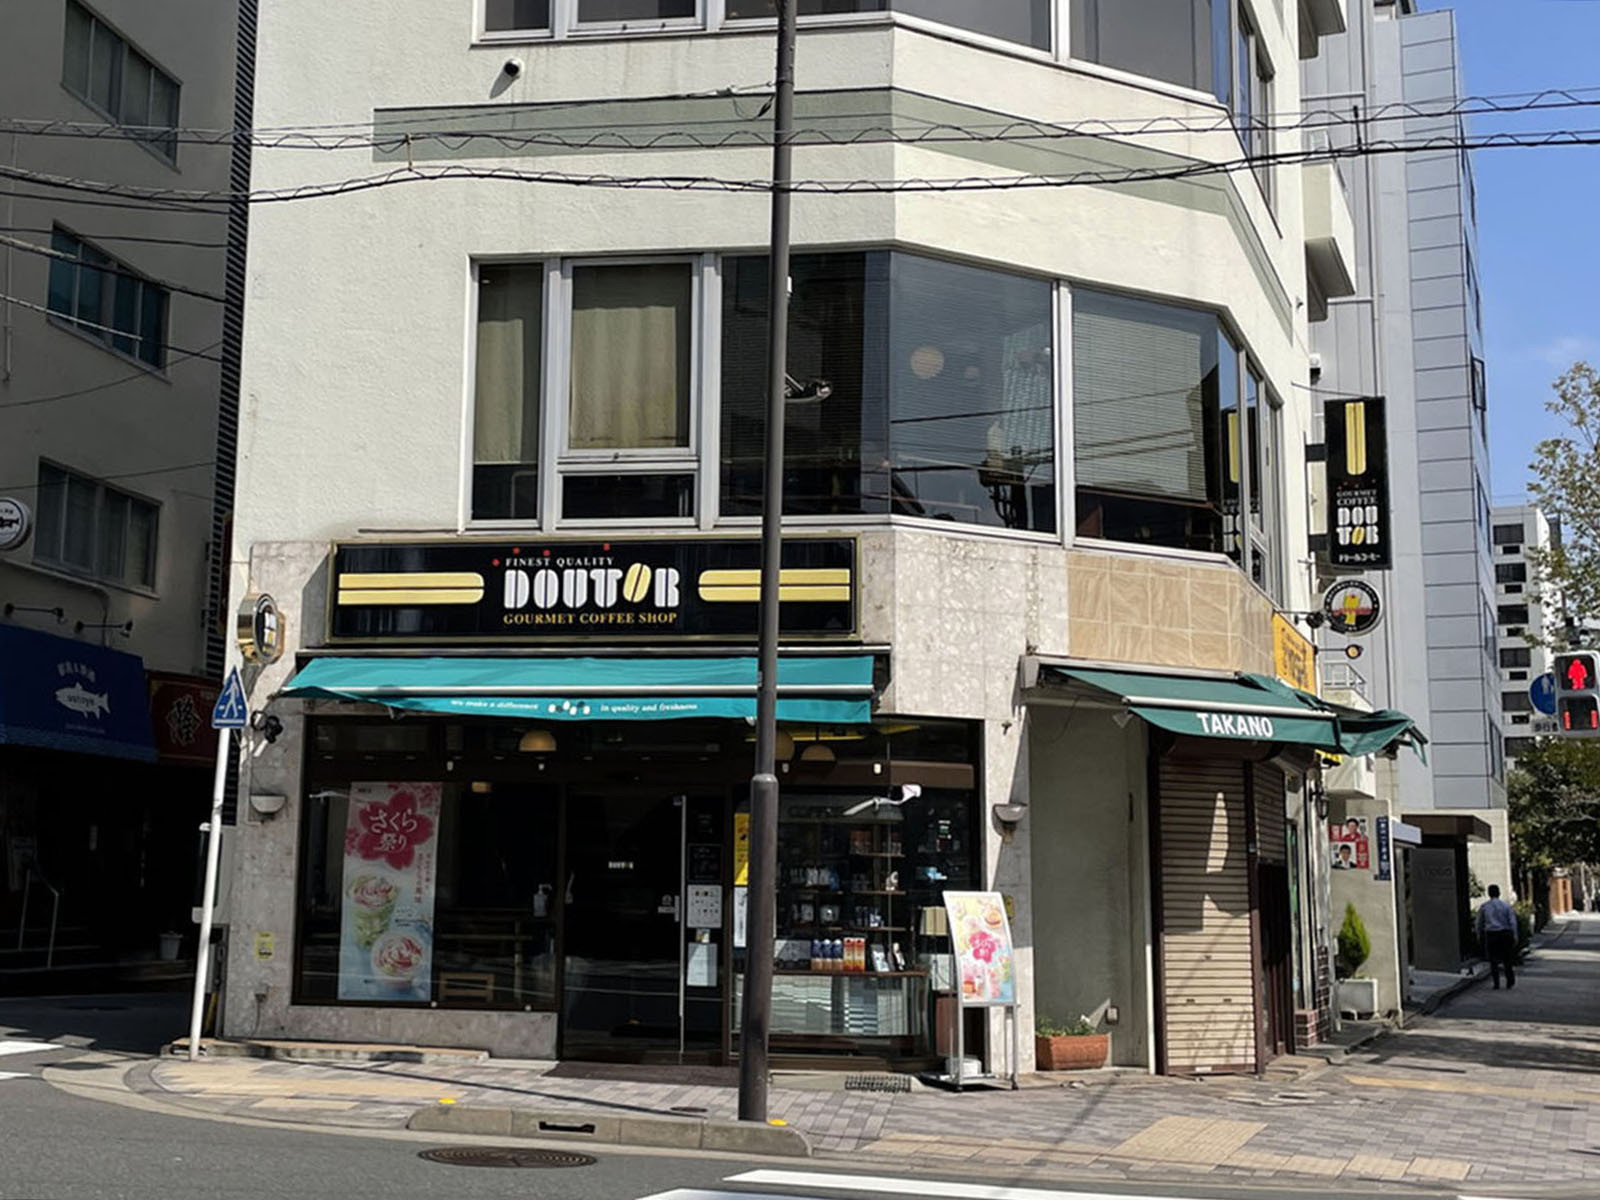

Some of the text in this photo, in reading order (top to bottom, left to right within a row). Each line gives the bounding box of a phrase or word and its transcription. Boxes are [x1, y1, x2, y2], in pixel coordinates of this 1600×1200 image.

[1337, 505, 1378, 526] DOU
[1336, 525, 1379, 545] TOR
[505, 556, 614, 568] FINEST QUALITY
[503, 562, 680, 609] DOUTOR
[503, 612, 678, 625] GOURMET COFFEE SHOP
[641, 703, 657, 712] and
[1196, 712, 1274, 738] TAKANO
[369, 808, 418, 833] さくら
